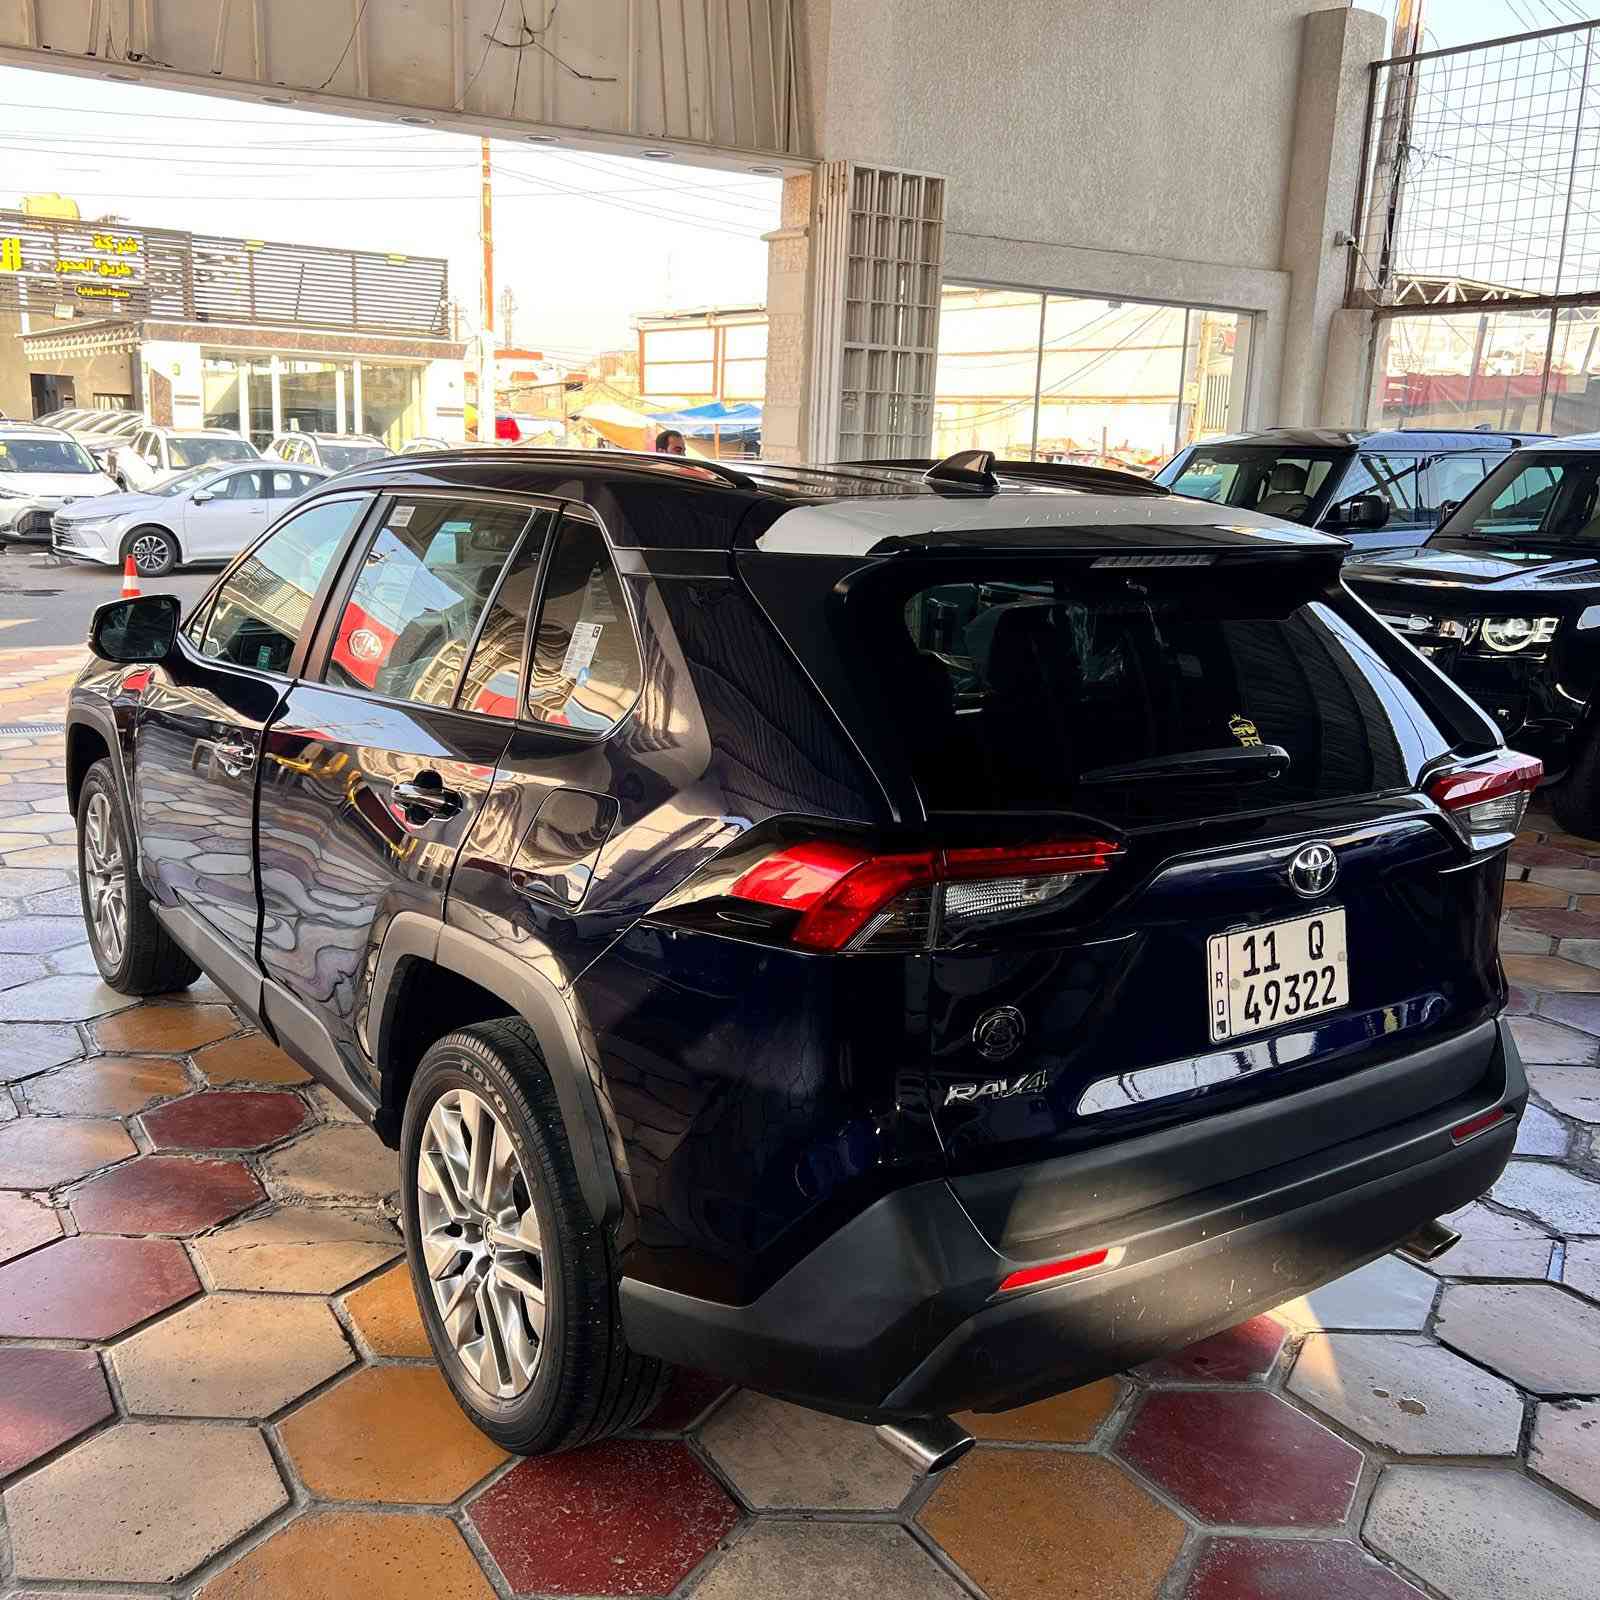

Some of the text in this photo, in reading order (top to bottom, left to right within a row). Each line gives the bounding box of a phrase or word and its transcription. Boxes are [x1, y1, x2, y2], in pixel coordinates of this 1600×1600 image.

[94, 232, 138, 255] شركة
[55, 257, 133, 277] طريق المحور
[1243, 920, 1324, 977] 11 Q
[1244, 965, 1337, 1024] 49322
[461, 1059, 509, 1115] TOYO
[944, 1069, 1048, 1106] RAV4
